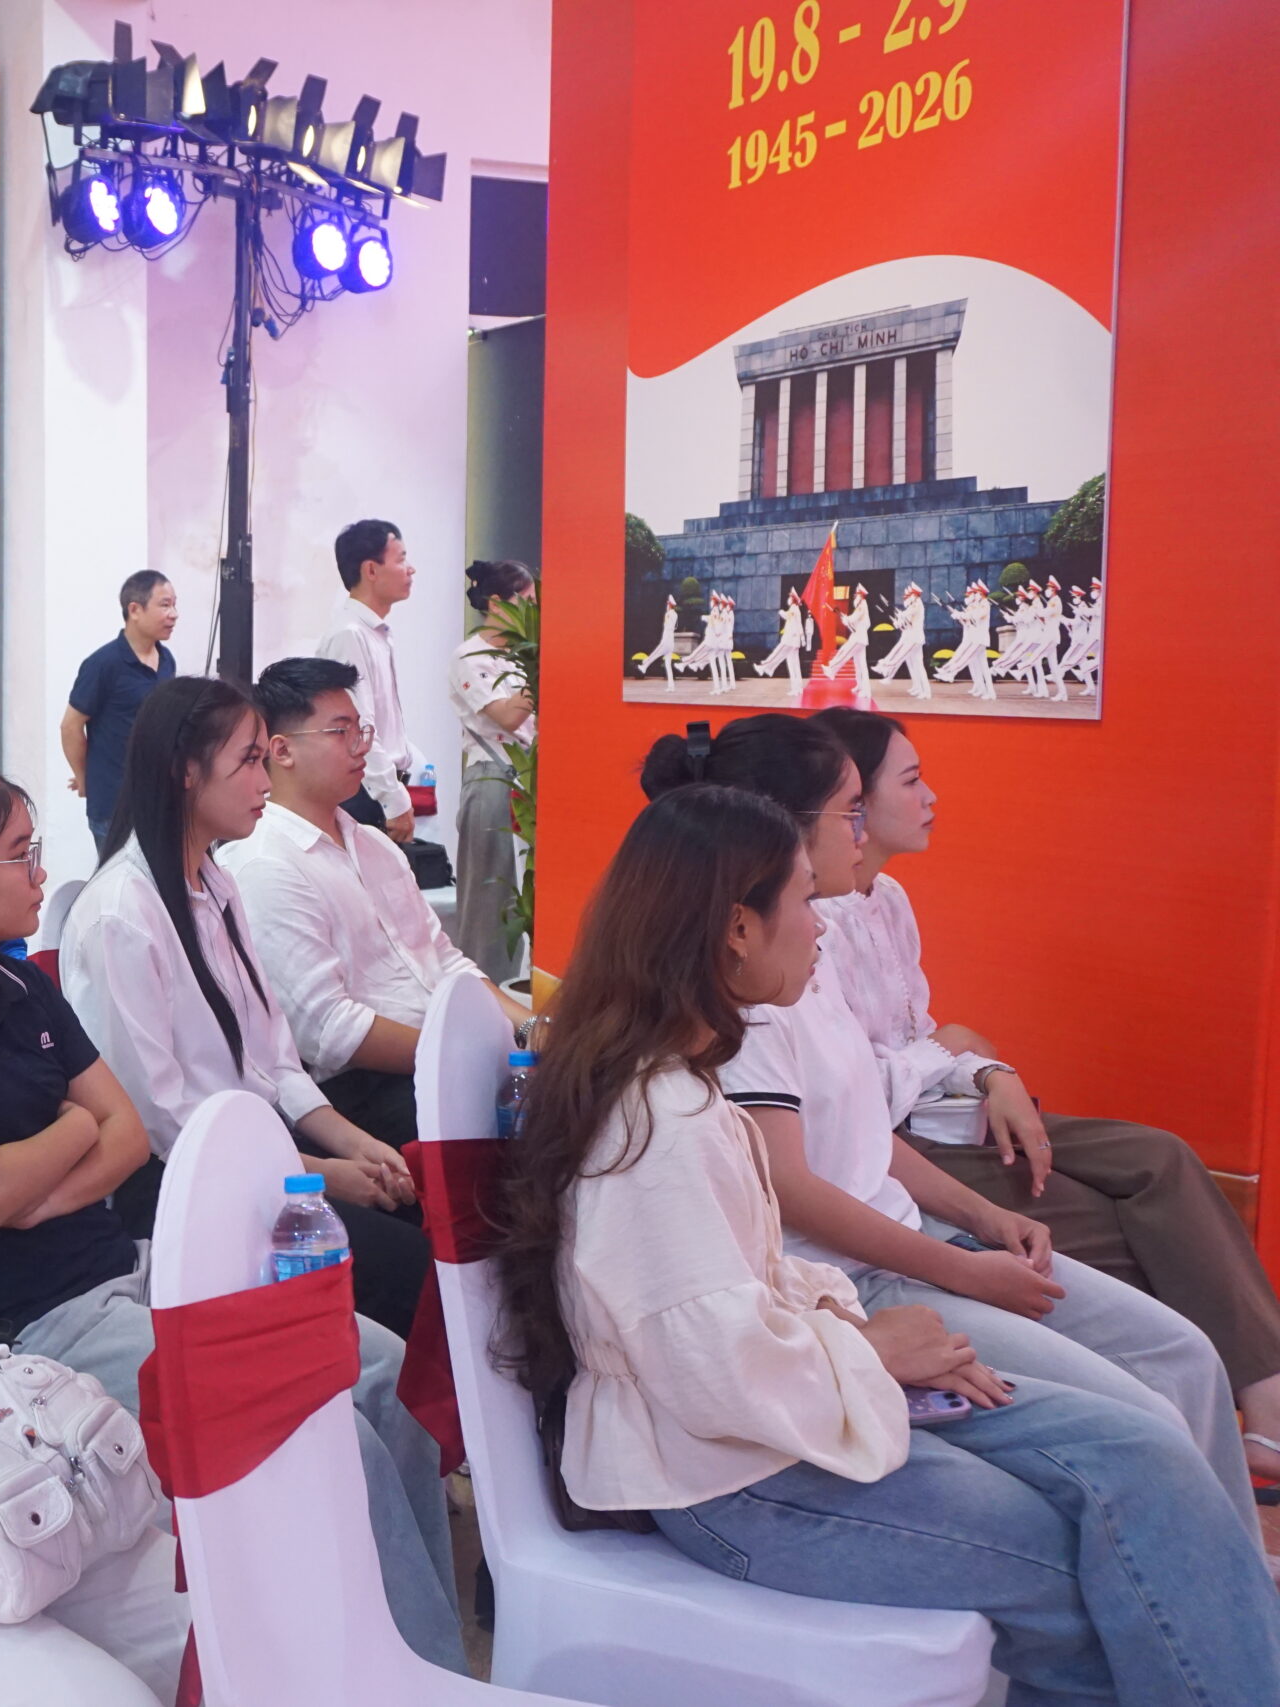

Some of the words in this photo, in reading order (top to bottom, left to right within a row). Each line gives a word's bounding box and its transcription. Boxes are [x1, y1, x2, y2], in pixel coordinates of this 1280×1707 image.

[727, 0, 820, 110] 19.8
[727, 110, 818, 190] 1945
[857, 58, 973, 150] 2026
